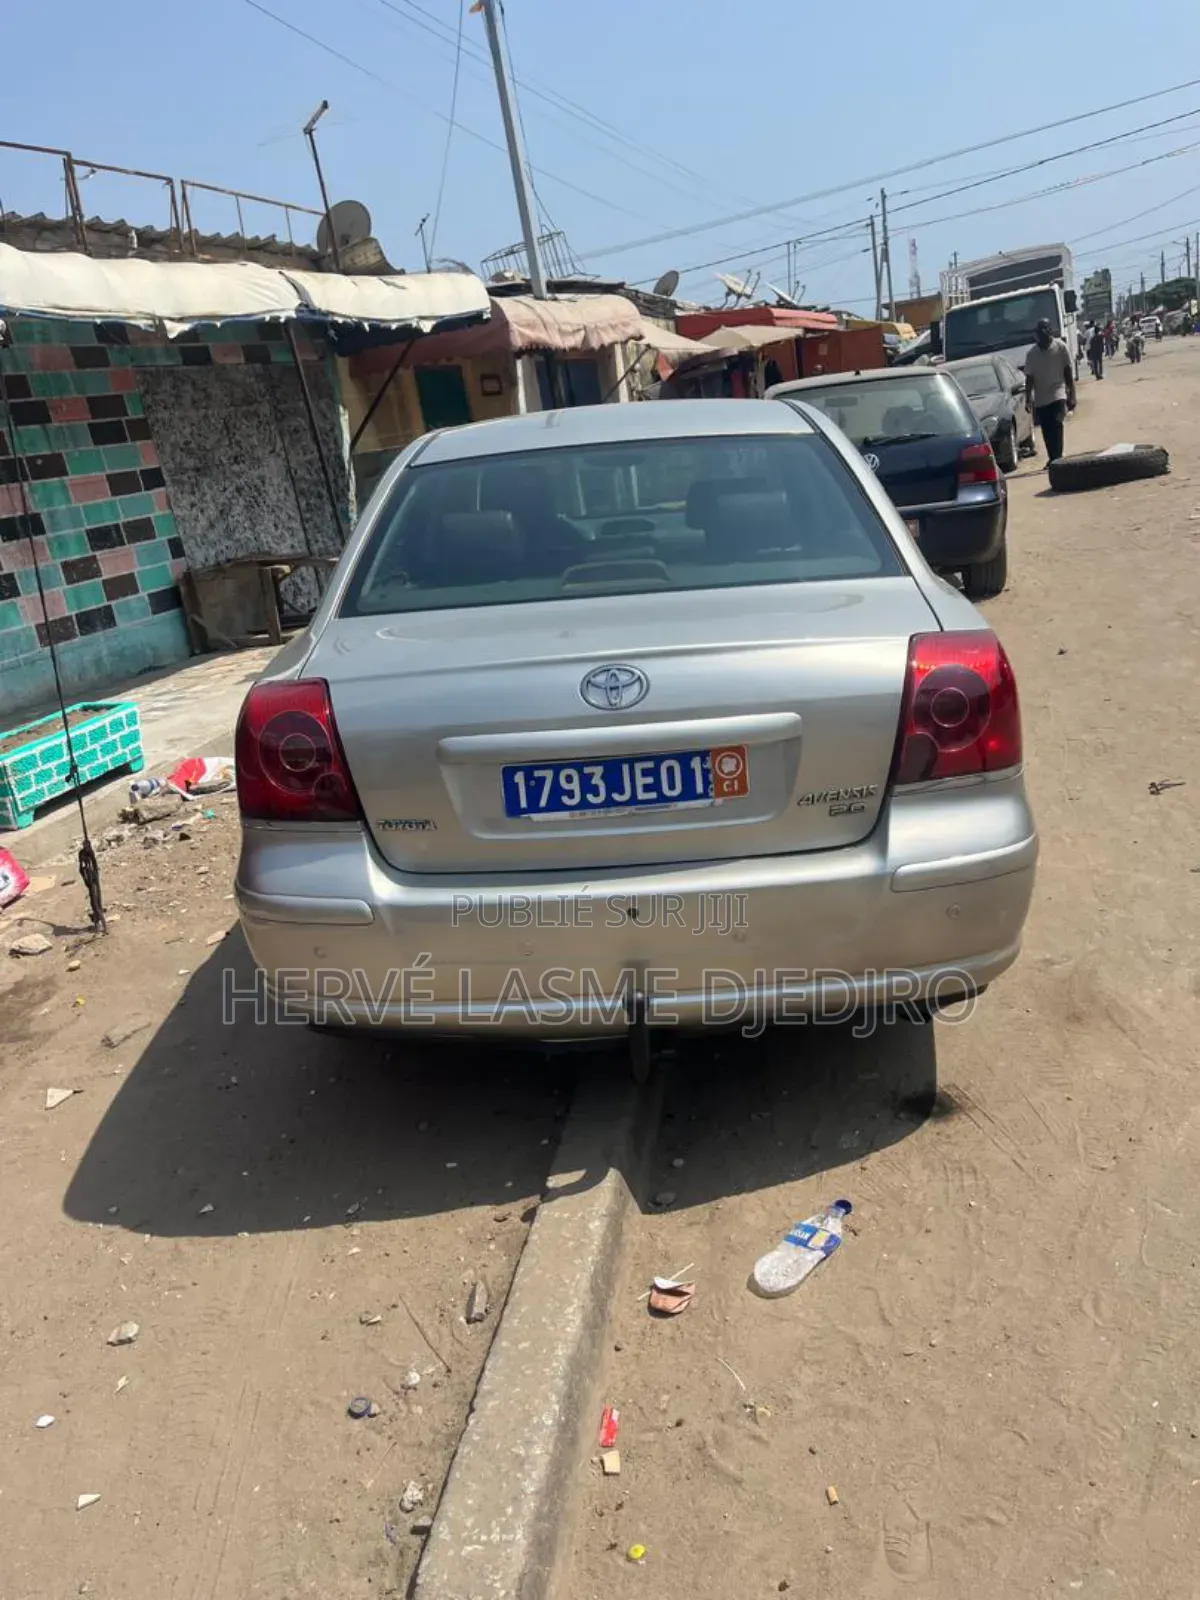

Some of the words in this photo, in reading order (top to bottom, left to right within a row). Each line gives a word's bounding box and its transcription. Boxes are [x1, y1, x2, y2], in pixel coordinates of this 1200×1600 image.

[723, 779, 739, 792] CI
[797, 784, 878, 806] AVENSIS
[376, 819, 437, 831] TOYOTA
